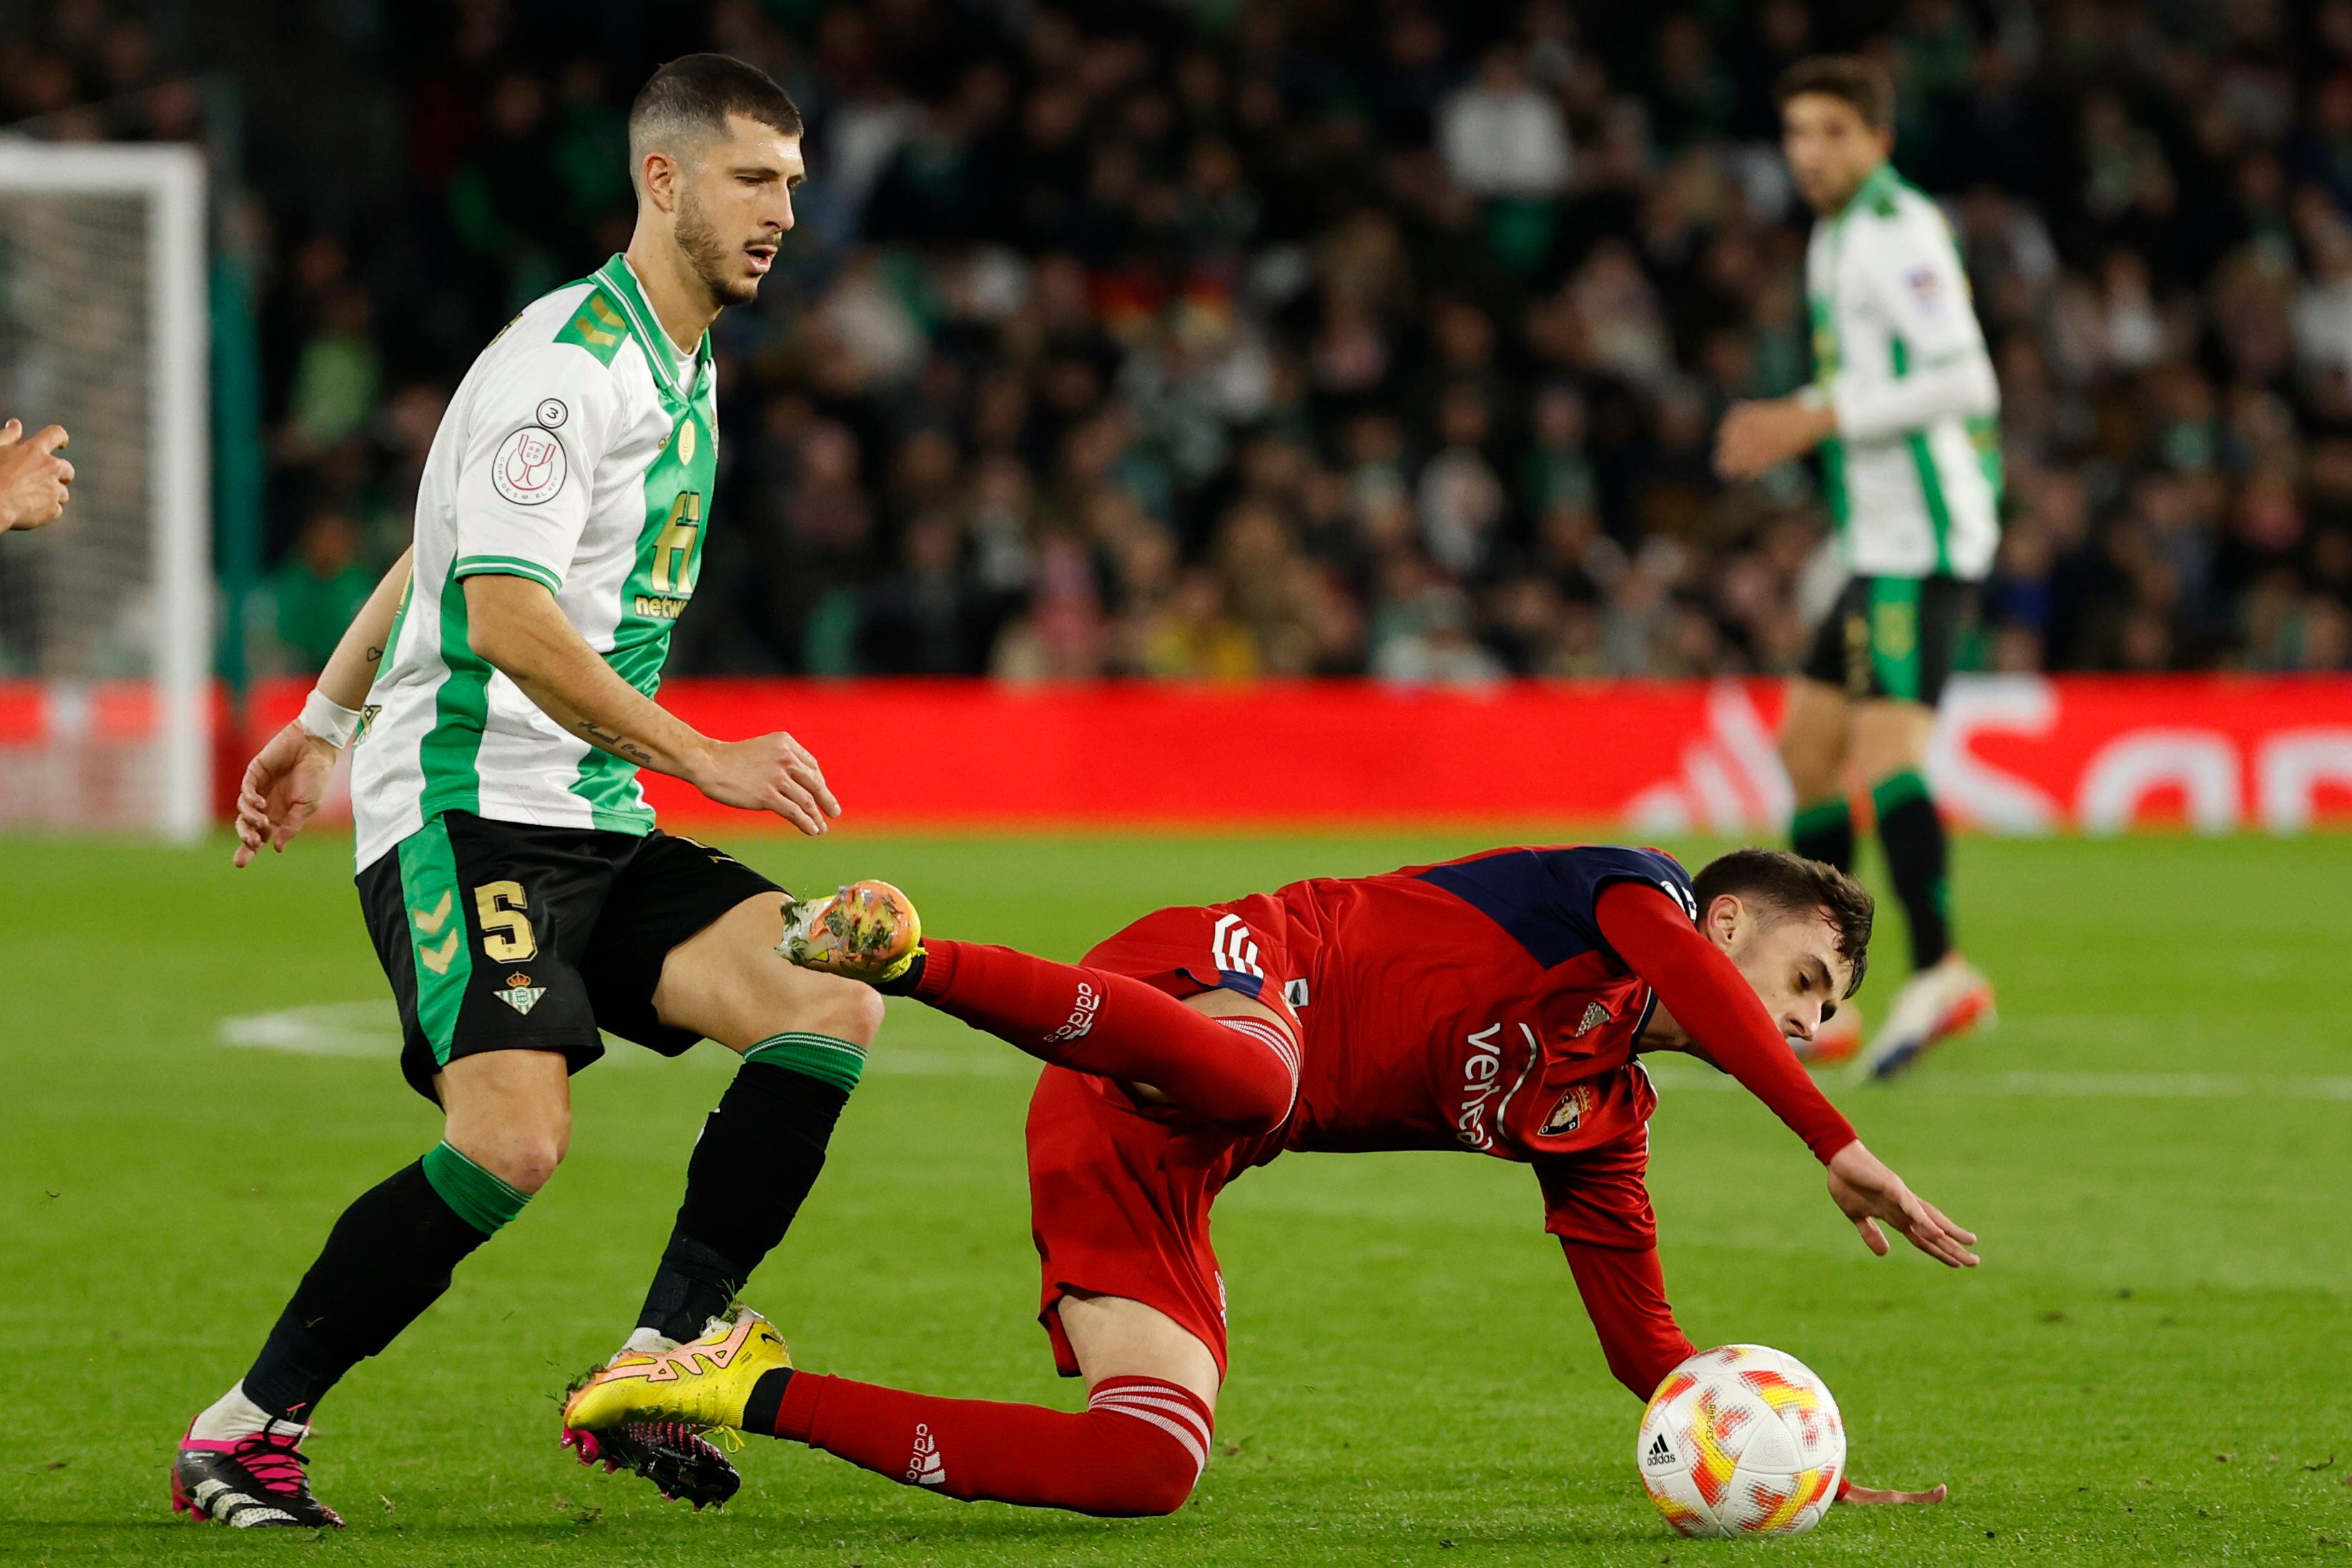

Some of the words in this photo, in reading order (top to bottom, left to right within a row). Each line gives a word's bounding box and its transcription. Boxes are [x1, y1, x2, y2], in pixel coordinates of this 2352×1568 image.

[545, 407, 559, 419] 3
[474, 880, 538, 964] 5
[1043, 982, 1095, 1042] adidas
[904, 1423, 929, 1483] adida
[1647, 1452, 1676, 1466] adidas
